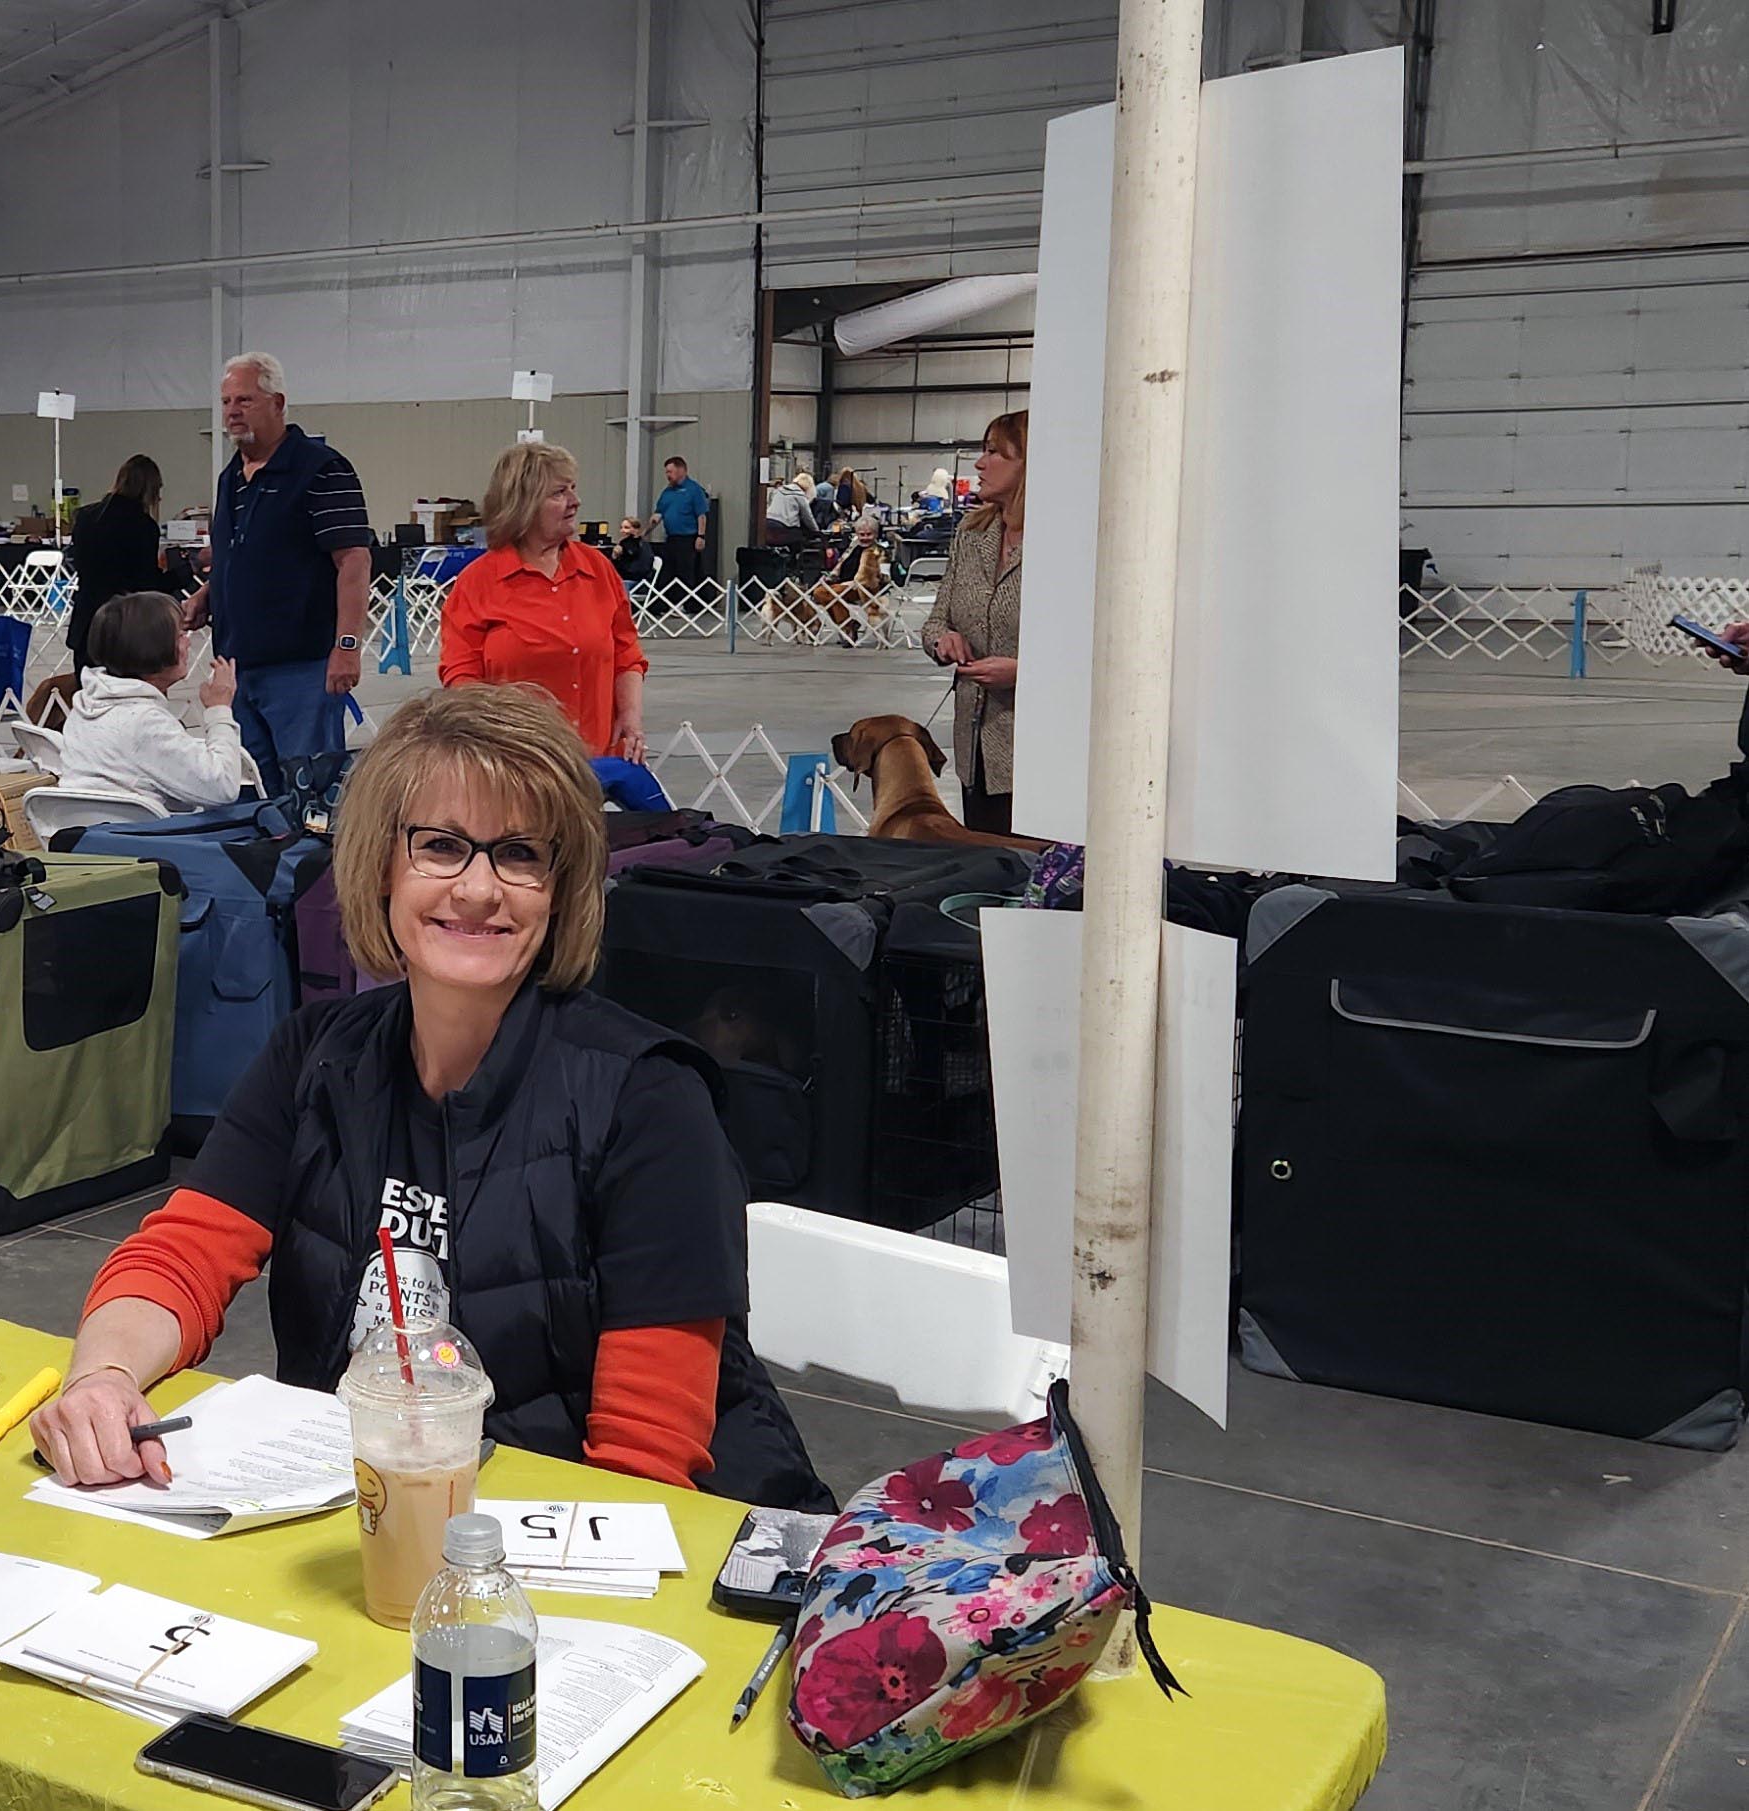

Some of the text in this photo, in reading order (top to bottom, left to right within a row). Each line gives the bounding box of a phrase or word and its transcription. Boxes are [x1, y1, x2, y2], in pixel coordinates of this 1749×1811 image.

[377, 1207, 448, 1260] DUT
[370, 1266, 408, 1285] Ases
[412, 1277, 425, 1289] to
[369, 1281, 431, 1307] PONTS
[375, 1301, 383, 1311] a
[520, 1514, 557, 1540] 5
[149, 1625, 211, 1656] 5
[469, 1734, 504, 1746] USAA
